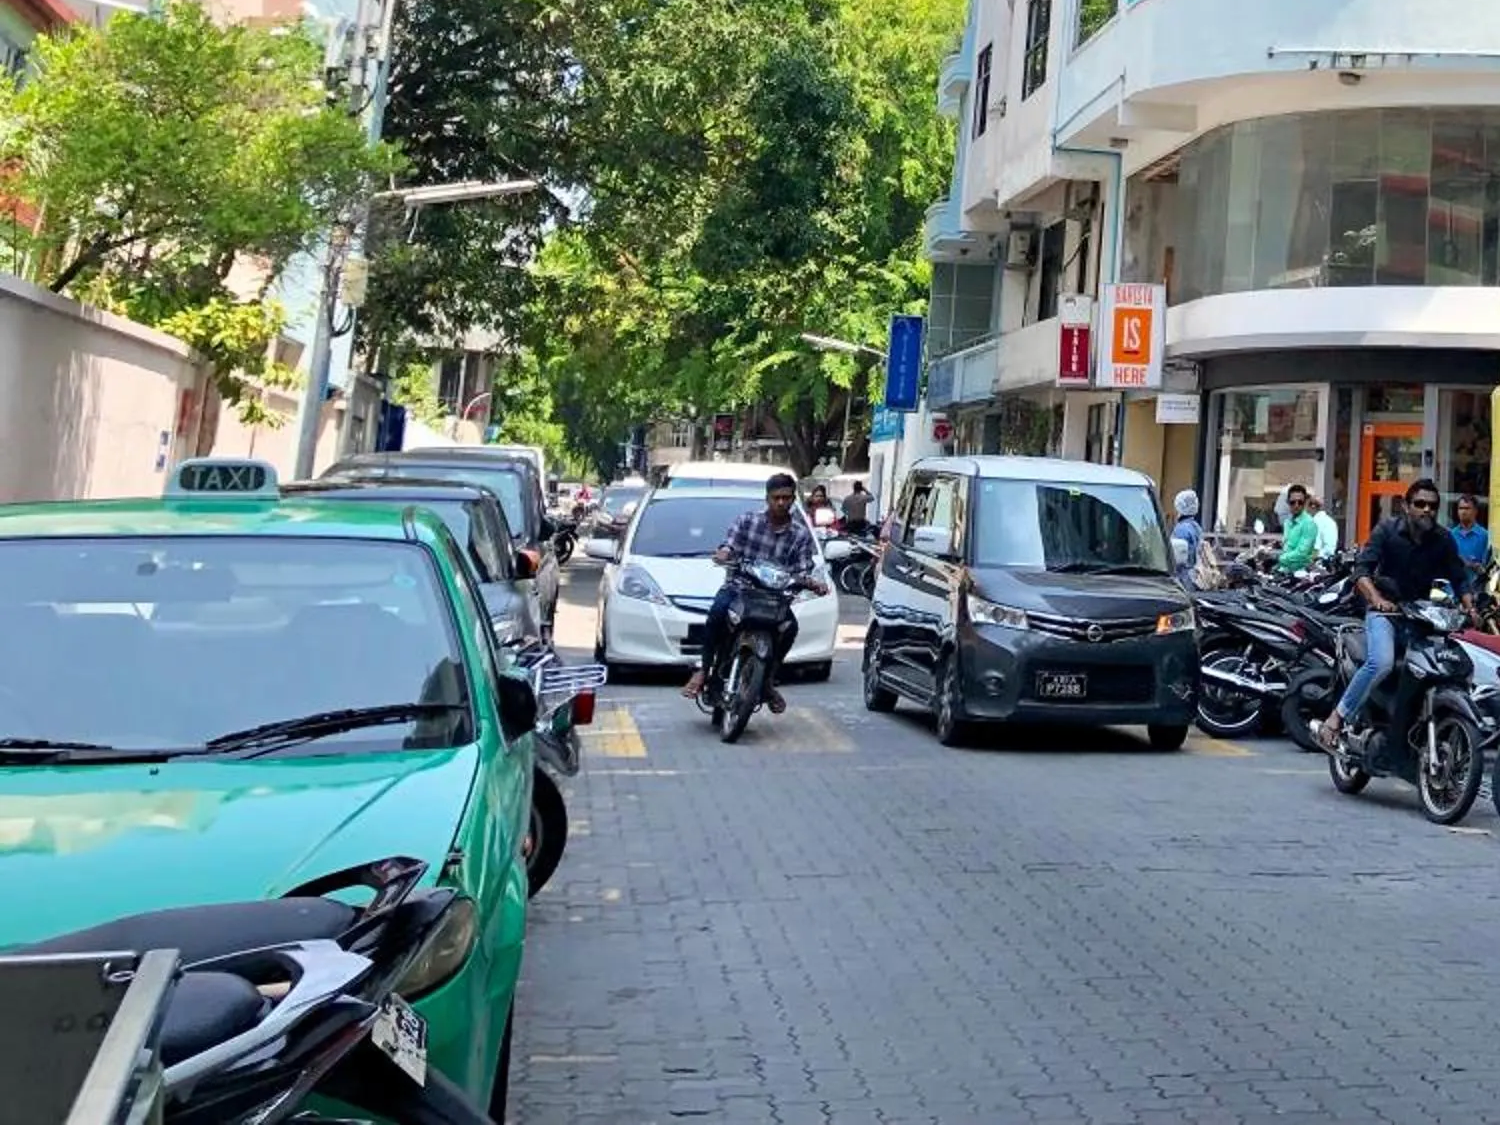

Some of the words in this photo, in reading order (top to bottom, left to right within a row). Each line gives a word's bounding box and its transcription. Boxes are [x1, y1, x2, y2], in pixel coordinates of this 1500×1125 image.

[1122, 315, 1141, 349] IS
[1113, 366, 1147, 385] HERE
[192, 466, 256, 491] TAXI
